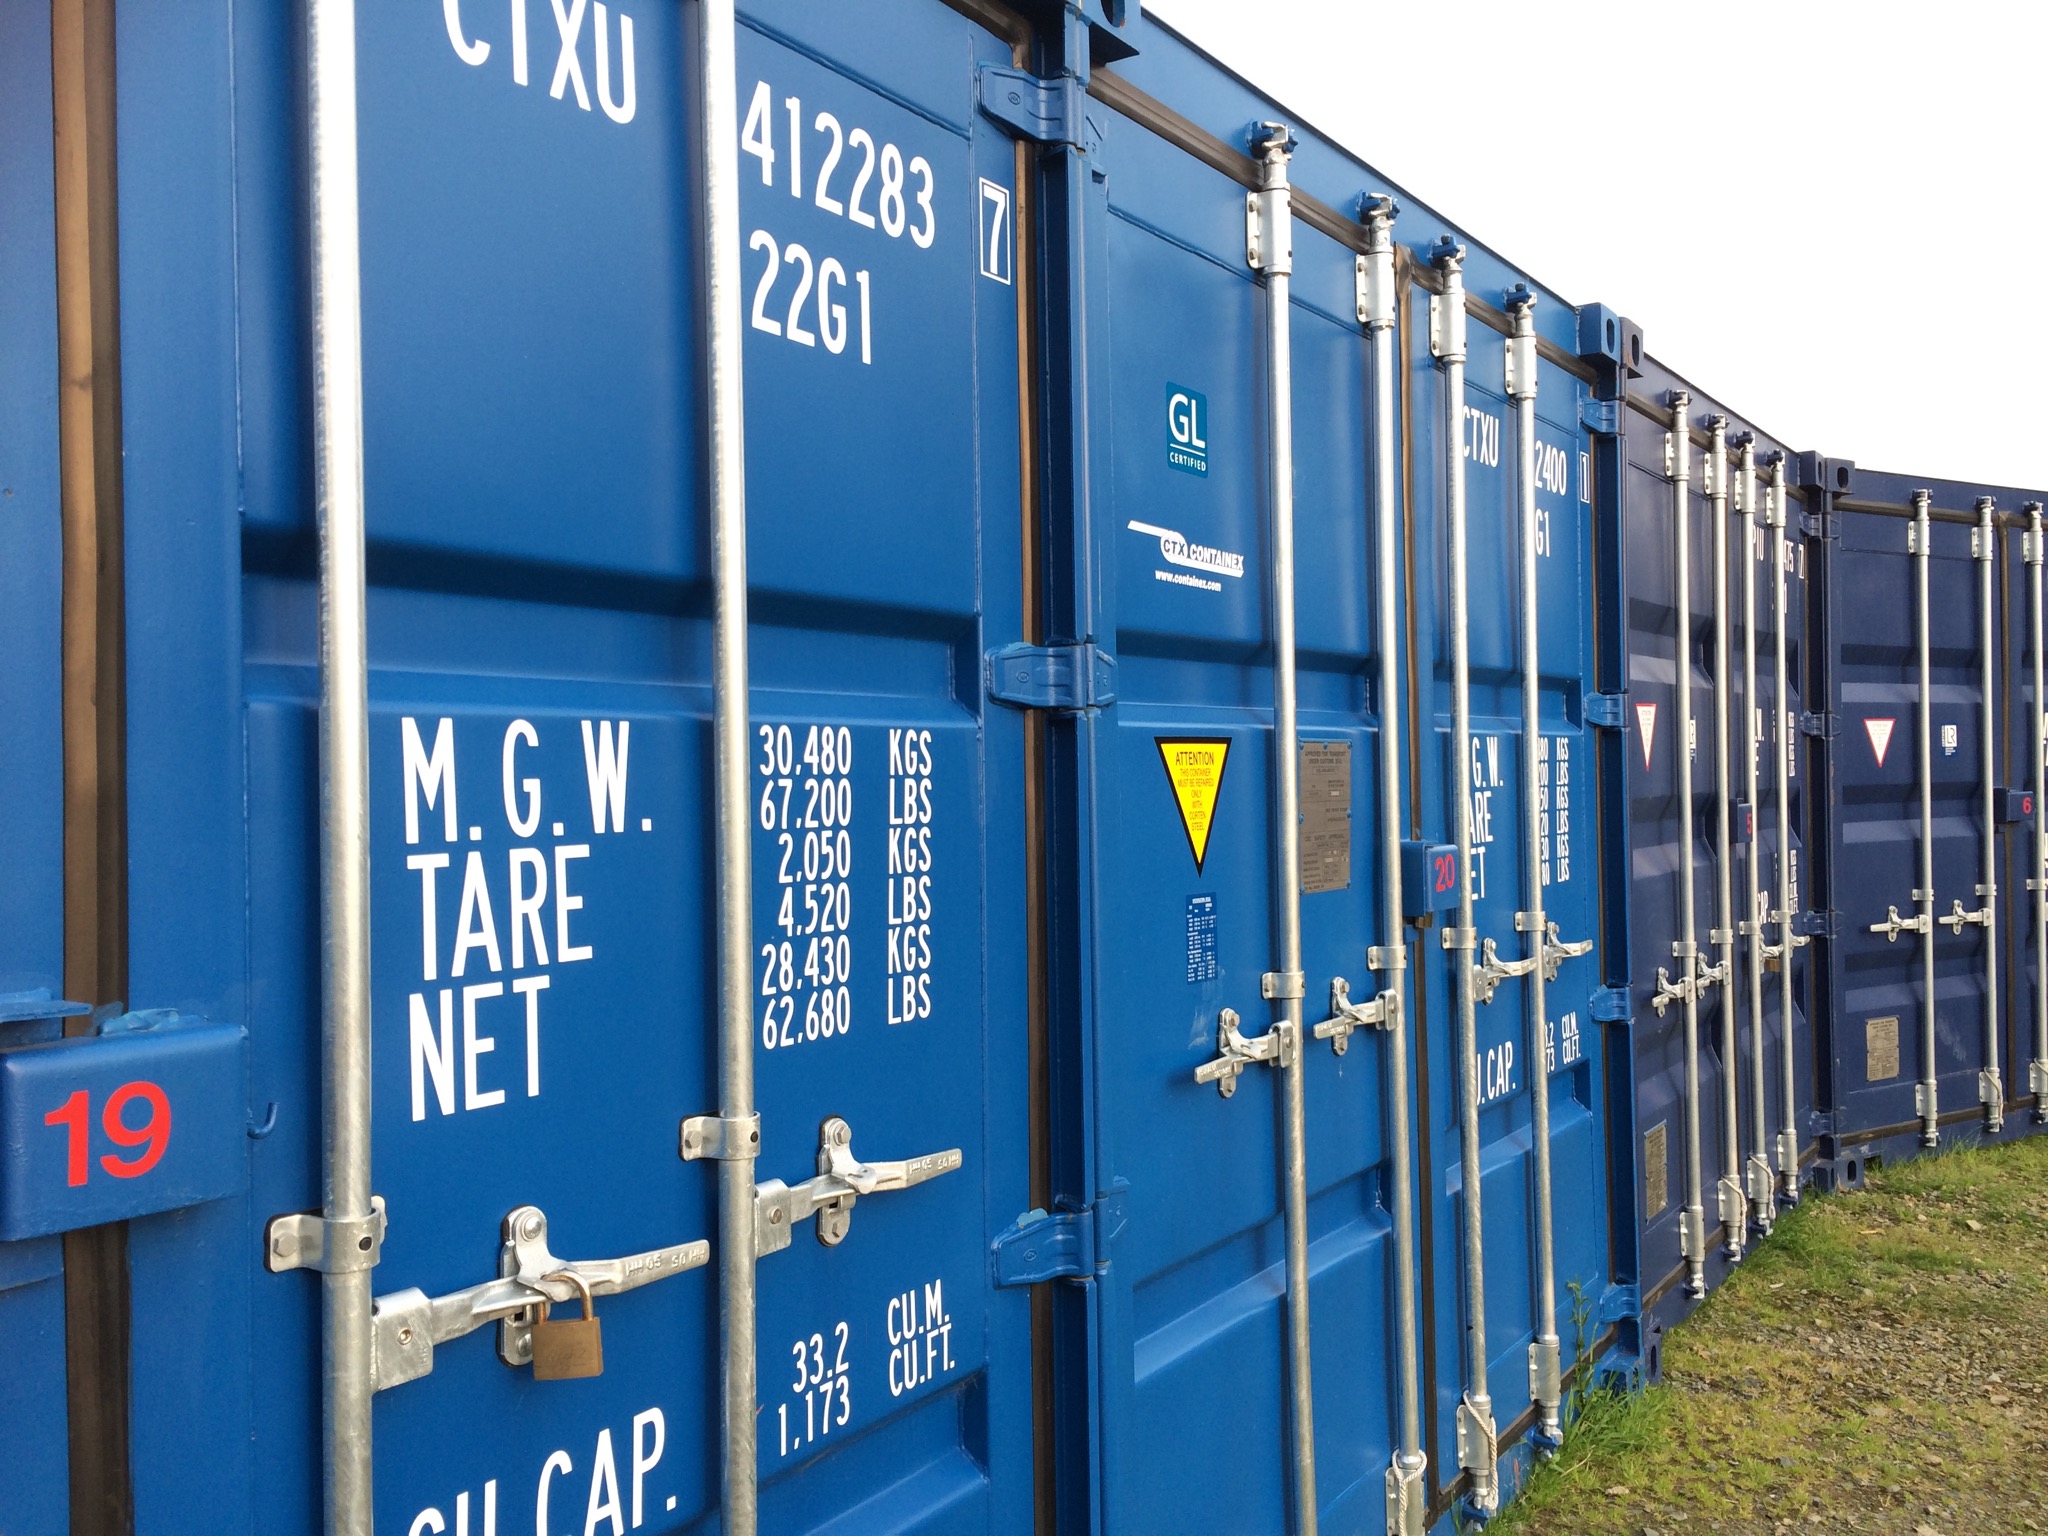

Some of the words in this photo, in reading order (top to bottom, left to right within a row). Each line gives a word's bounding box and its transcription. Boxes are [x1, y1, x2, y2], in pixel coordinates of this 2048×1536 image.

[741, 80, 935, 249] 412283
[983, 186, 1006, 276] 7
[749, 229, 871, 365] 22G1
[1169, 393, 1206, 449] GL
[1169, 451, 1206, 472] CERTIFIED
[1463, 405, 1499, 467] CTXU
[1535, 440, 1567, 496] 2400
[1162, 538, 1186, 558] CTX
[1189, 543, 1245, 572] CONTAINEX
[1535, 508, 1550, 557] G1
[1154, 570, 1222, 593] www.containex.com
[760, 725, 851, 777] 30,480
[890, 729, 932, 776] KGS
[1175, 751, 1215, 766] ATTENTION
[1556, 737, 1569, 760] KGS
[1556, 762, 1568, 785] LBS
[760, 778, 851, 831] 67,200
[889, 778, 931, 825] LBS
[1469, 790, 1494, 844] ARE
[1556, 786, 1569, 809] KGS
[1556, 810, 1569, 834] LBS
[2022, 797, 2033, 814] 6
[1434, 853, 1456, 892] 20
[1470, 846, 1486, 900] ET
[1557, 834, 1570, 858] KGS
[1557, 858, 1570, 882] LBS
[407, 844, 593, 981] TARE
[779, 830, 851, 885] 2,050
[889, 827, 931, 874] KGS
[779, 882, 850, 936] 4,520
[889, 875, 931, 924] LBS
[410, 975, 550, 1122] NET
[761, 935, 850, 995] 28,430
[888, 924, 931, 974] KGS
[762, 986, 850, 1050] 62,680
[888, 973, 931, 1025] LBS
[44, 1080, 172, 1188] 19
[793, 1321, 849, 1393] 33.2
[888, 1279, 951, 1346] CU.M.
[778, 1376, 850, 1457] 1,173
[889, 1322, 955, 1397] CU.FT.
